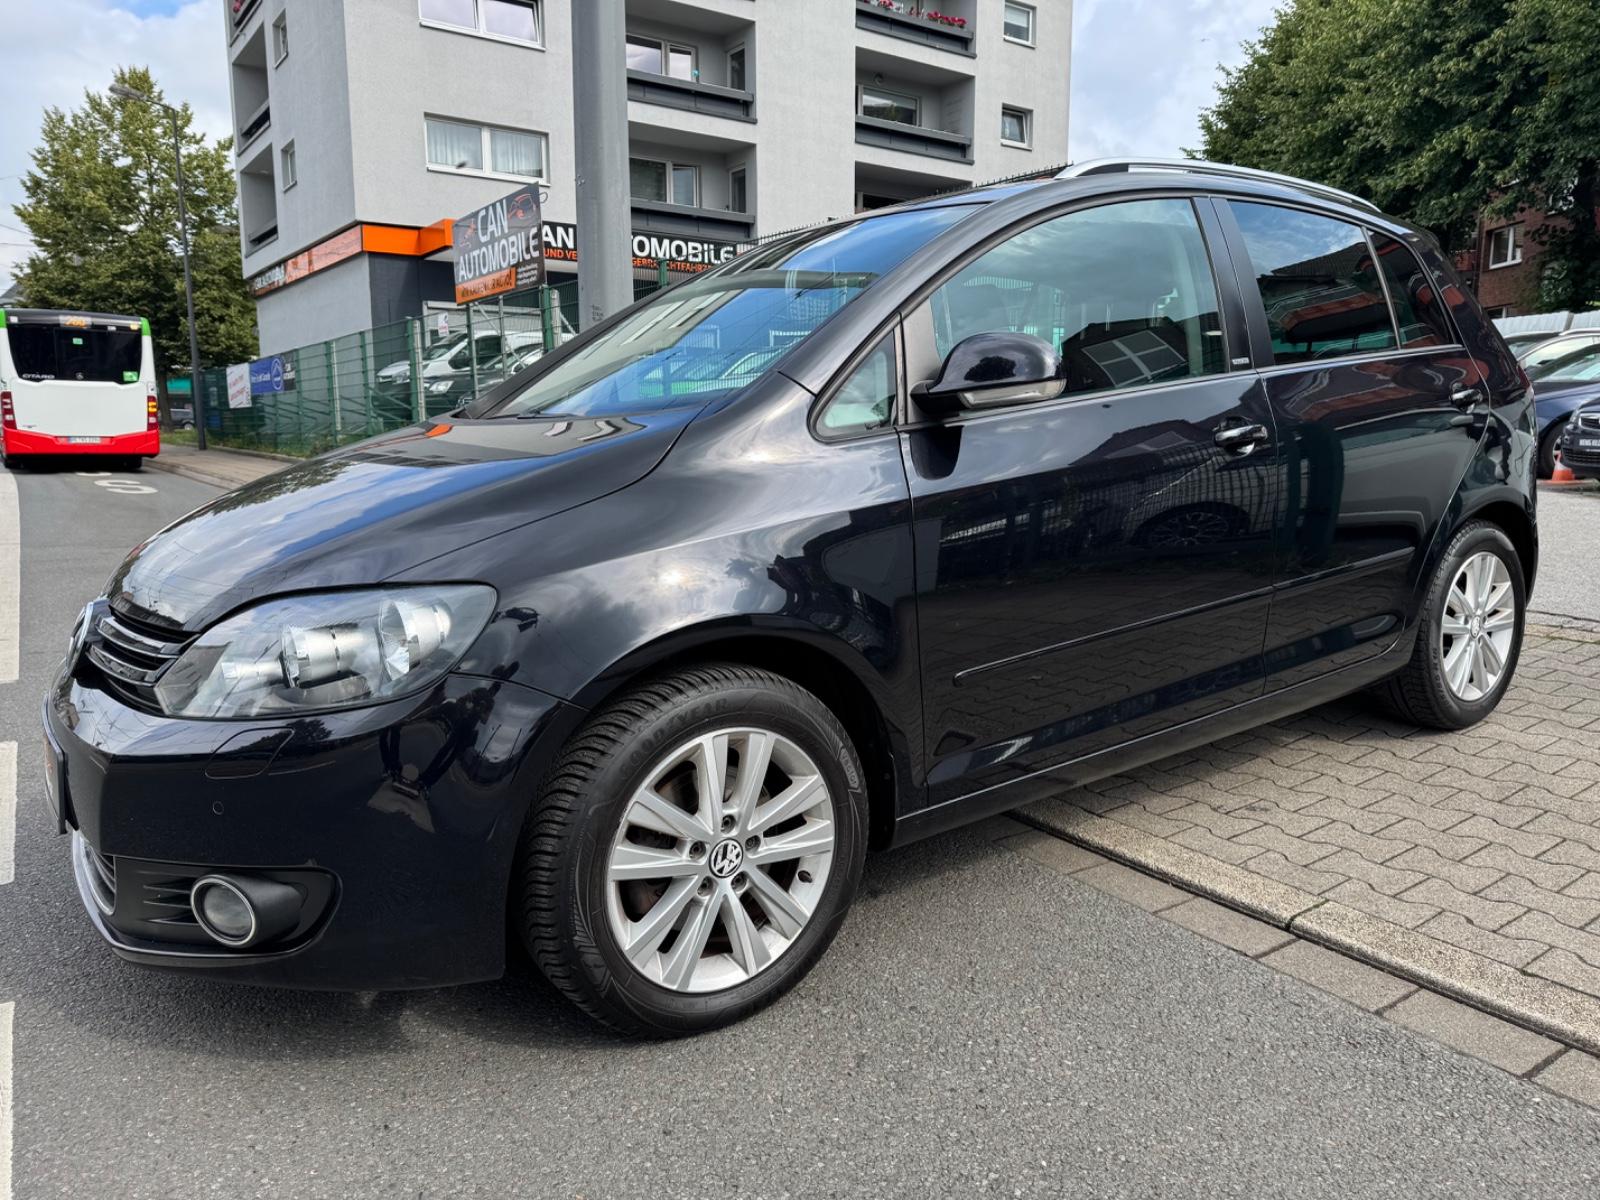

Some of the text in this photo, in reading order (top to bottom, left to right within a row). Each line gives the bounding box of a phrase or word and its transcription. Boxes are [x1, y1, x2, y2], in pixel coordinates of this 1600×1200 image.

[477, 198, 509, 243] CAN
[458, 226, 540, 282] AUTOMOBILE
[541, 224, 734, 264] AN OMOBILE
[543, 247, 564, 258] UND
[566, 249, 577, 260] VE
